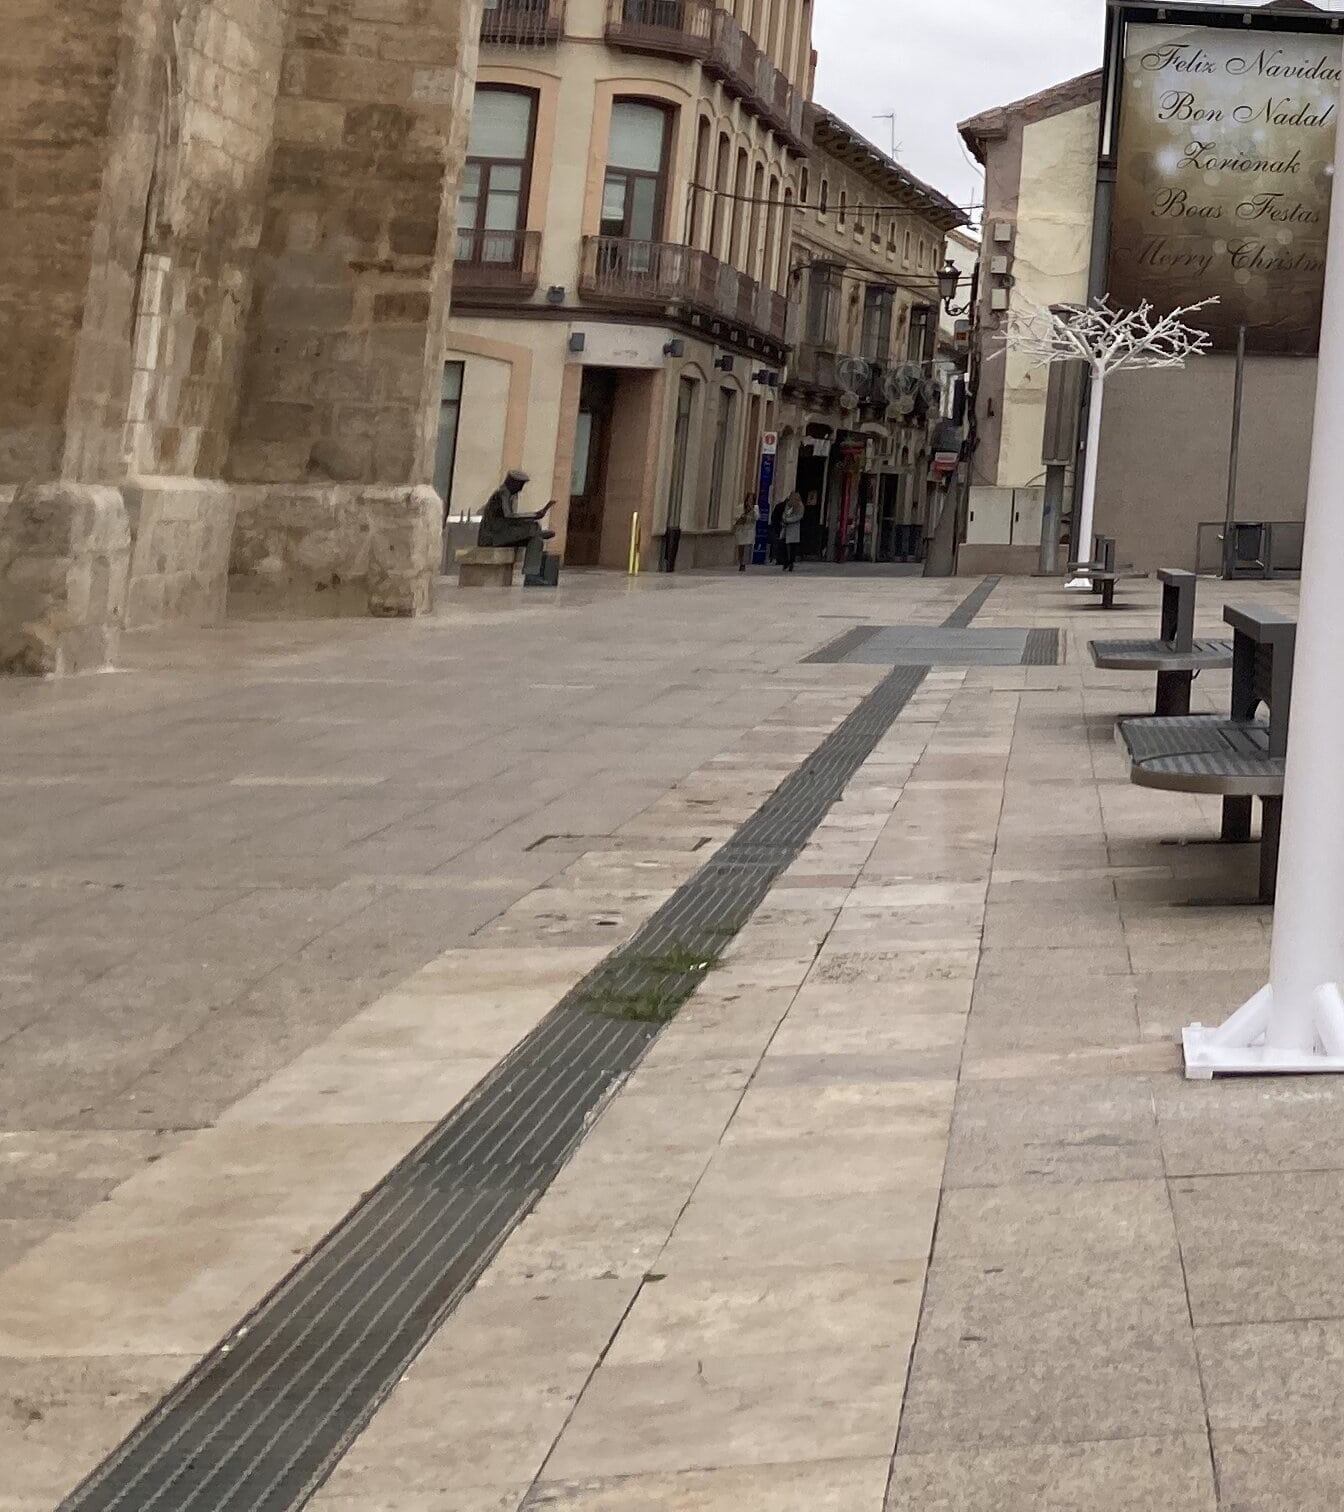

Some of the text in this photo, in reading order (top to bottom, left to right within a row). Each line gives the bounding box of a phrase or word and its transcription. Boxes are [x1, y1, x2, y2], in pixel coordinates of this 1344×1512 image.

[1140, 43, 1216, 74] Feliz
[1158, 89, 1335, 127] Bon Nadal
[1177, 140, 1301, 174] Zorionak
[1151, 187, 1319, 224] Boas Festas
[1113, 239, 1214, 275] Merry
